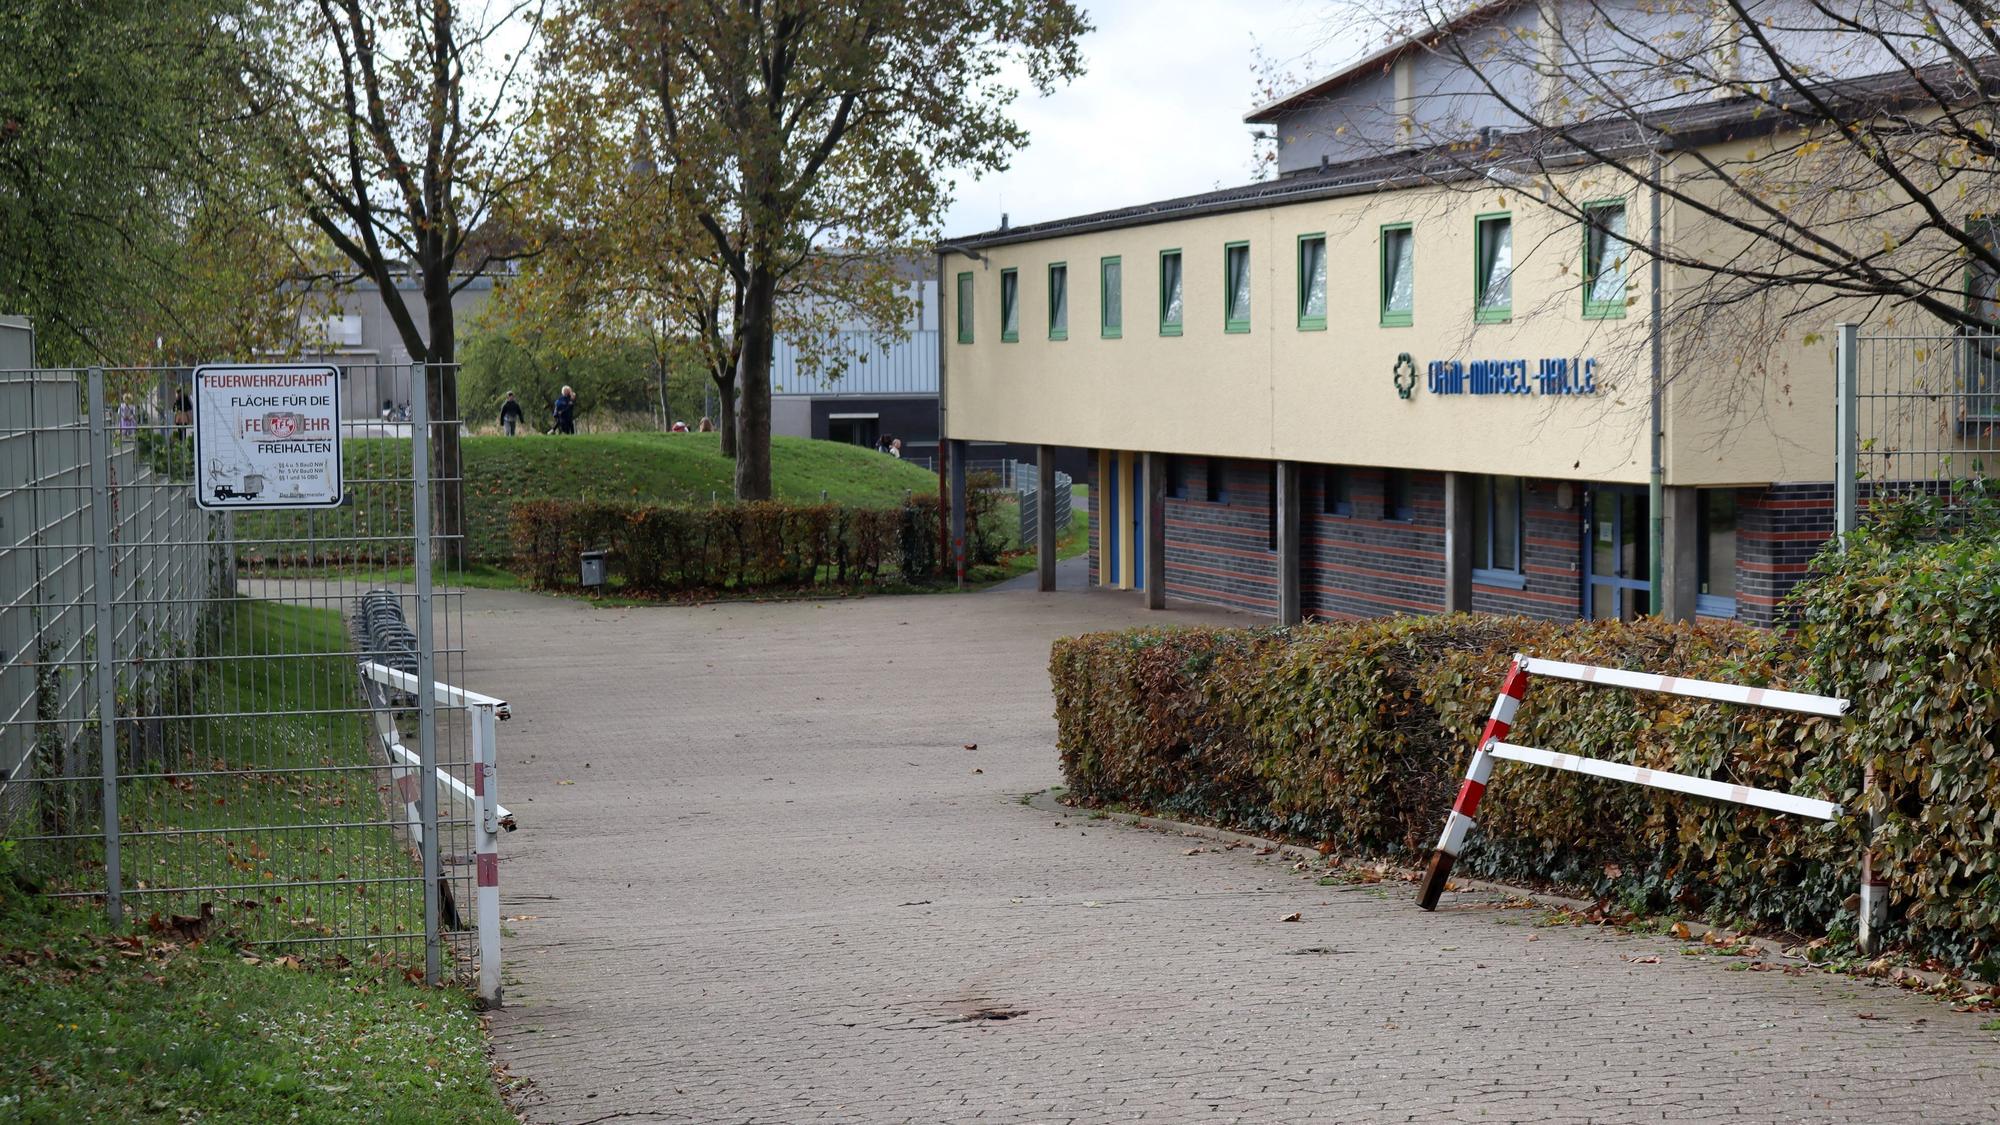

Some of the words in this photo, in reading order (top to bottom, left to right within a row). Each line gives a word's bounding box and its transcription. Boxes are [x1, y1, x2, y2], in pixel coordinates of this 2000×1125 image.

[204, 374, 329, 388] FEUERWEHRZUFAHRT
[231, 394, 279, 407] FLÄCHE
[282, 394, 307, 406] FÜR
[310, 396, 330, 406] DIE
[245, 418, 330, 432] FEEHR
[258, 443, 331, 454] FREIHALTEN
